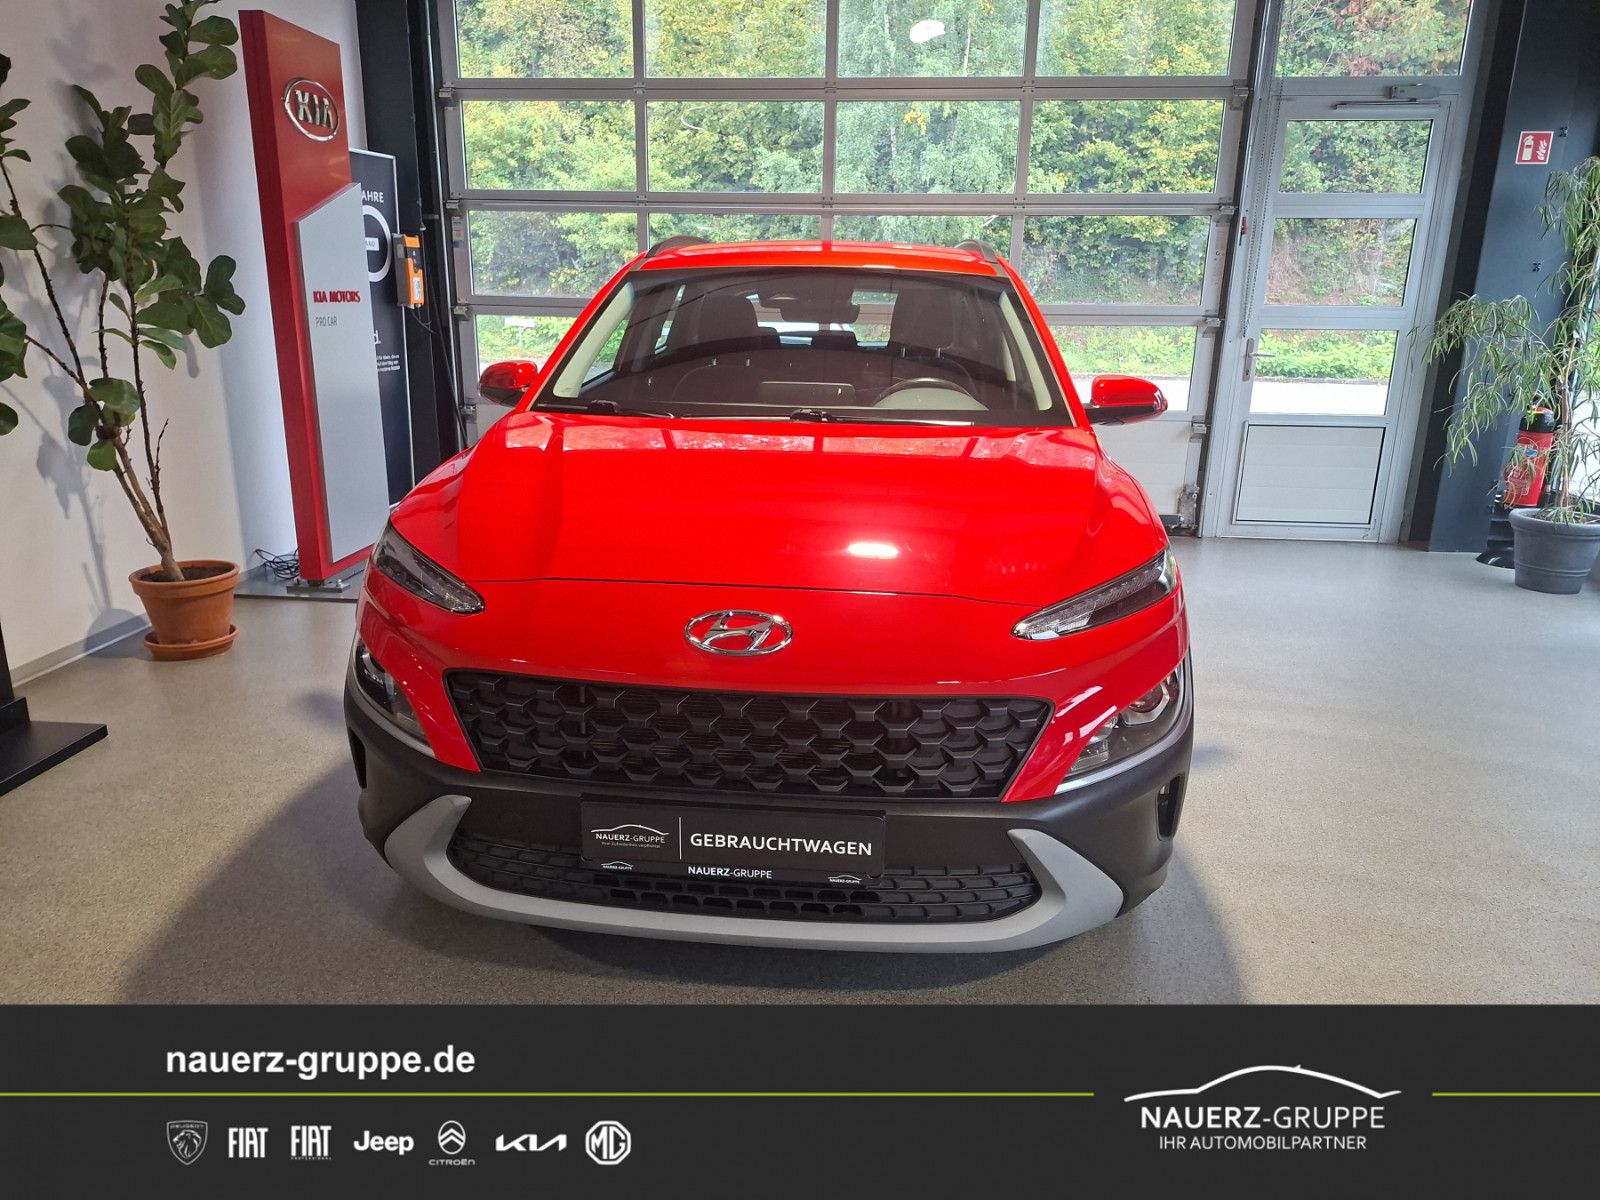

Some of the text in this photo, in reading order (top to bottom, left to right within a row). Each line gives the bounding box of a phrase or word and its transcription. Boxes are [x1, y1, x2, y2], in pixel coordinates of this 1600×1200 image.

[295, 89, 334, 130] KIA
[361, 190, 385, 203] AHRE
[313, 291, 361, 303] KIA MOTORS
[315, 315, 337, 327] PRO CAR
[595, 833, 665, 843] NAUERZ-GRUPPE
[690, 833, 873, 856] GEBRAUCHTWAGEN
[688, 866, 772, 879] NAUERZ-GRUPPE
